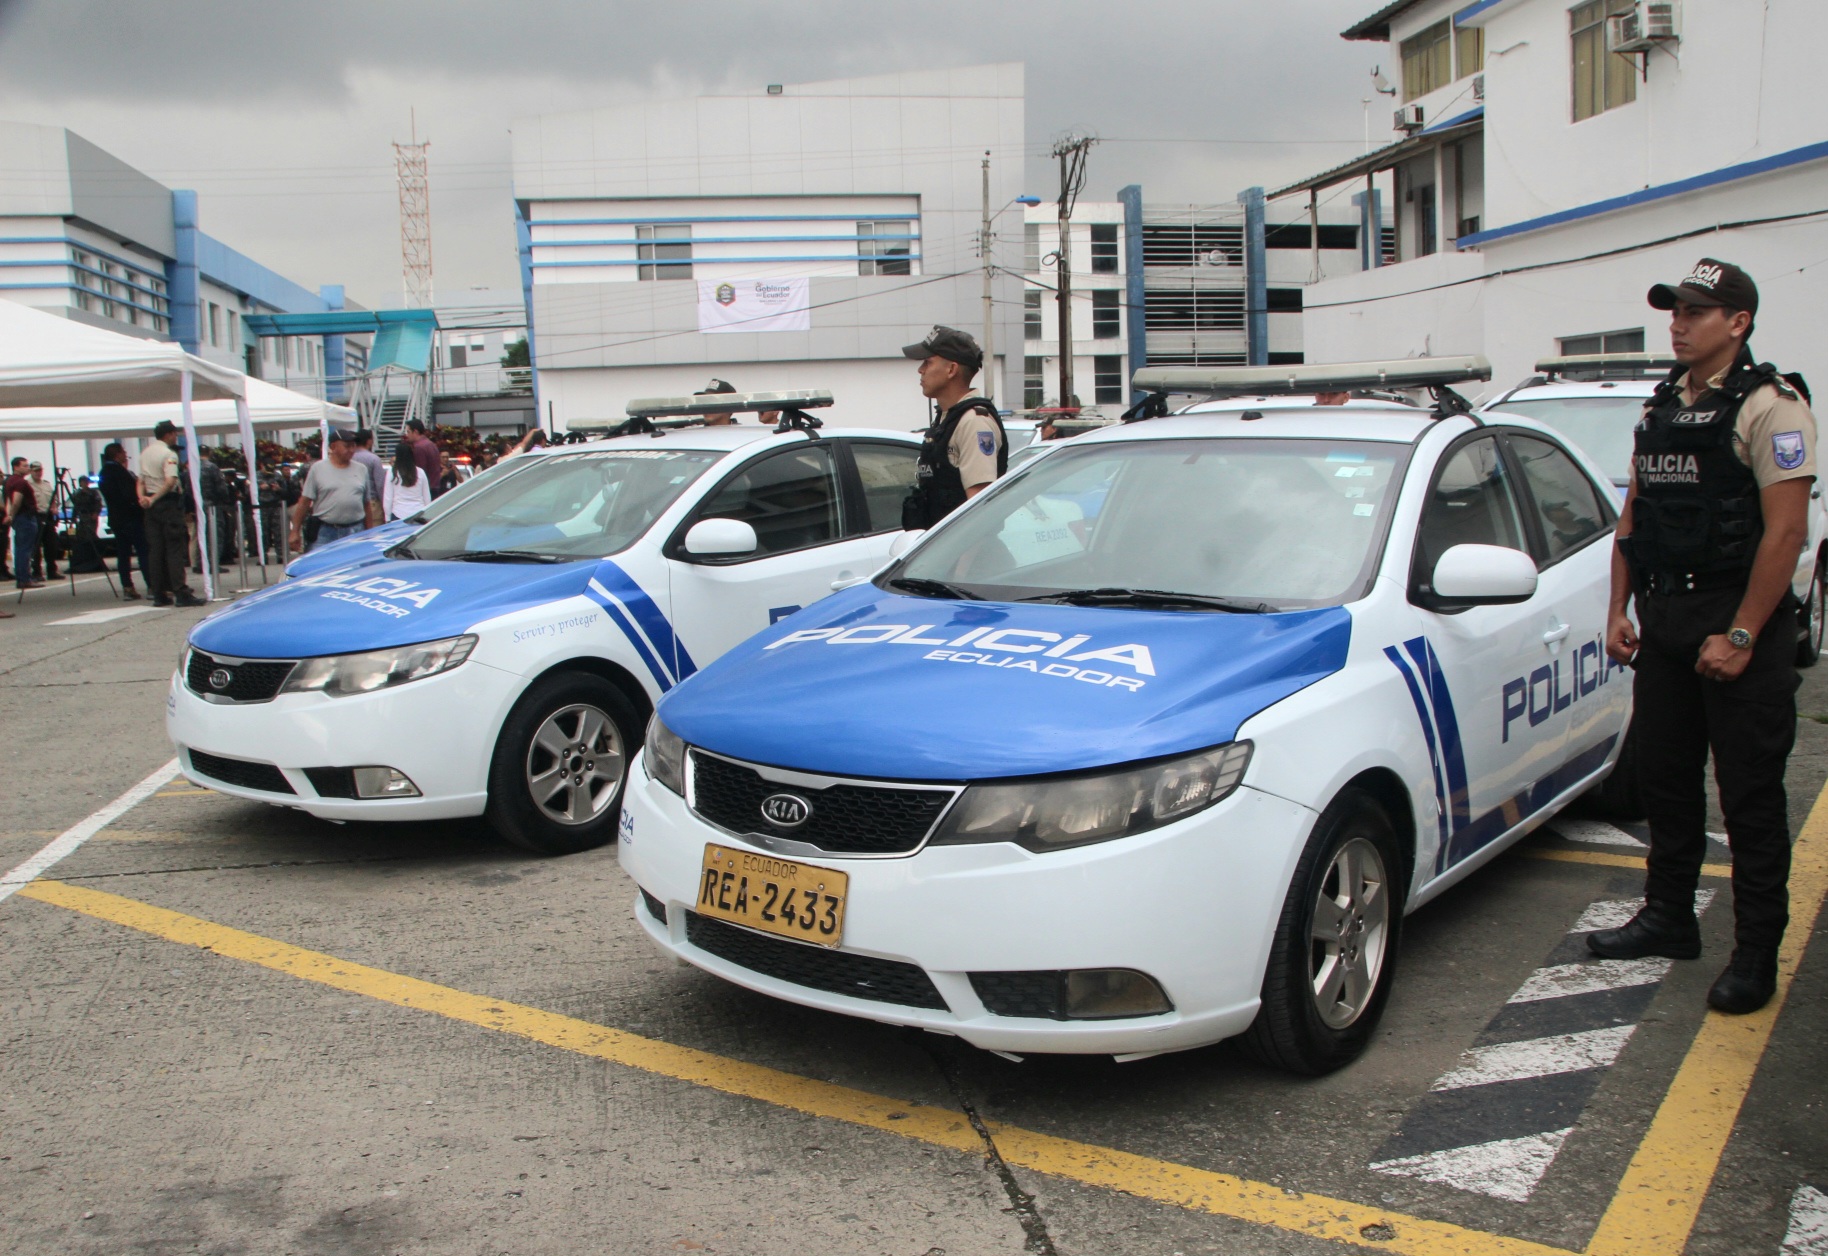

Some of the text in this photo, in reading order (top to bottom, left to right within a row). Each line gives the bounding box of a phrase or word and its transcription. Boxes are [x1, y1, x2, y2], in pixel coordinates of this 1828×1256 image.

[755, 284, 790, 293] Gobierno
[763, 290, 790, 299] Ecuador
[1648, 473, 1700, 484] NACIONAL
[320, 590, 411, 618] ECUADOR
[513, 613, 598, 643] Servir y proteger
[922, 649, 1146, 693] ECUADOR
[767, 806, 799, 822] KIA
[743, 855, 798, 880] ECUADOR
[702, 868, 839, 935] REA-2433
